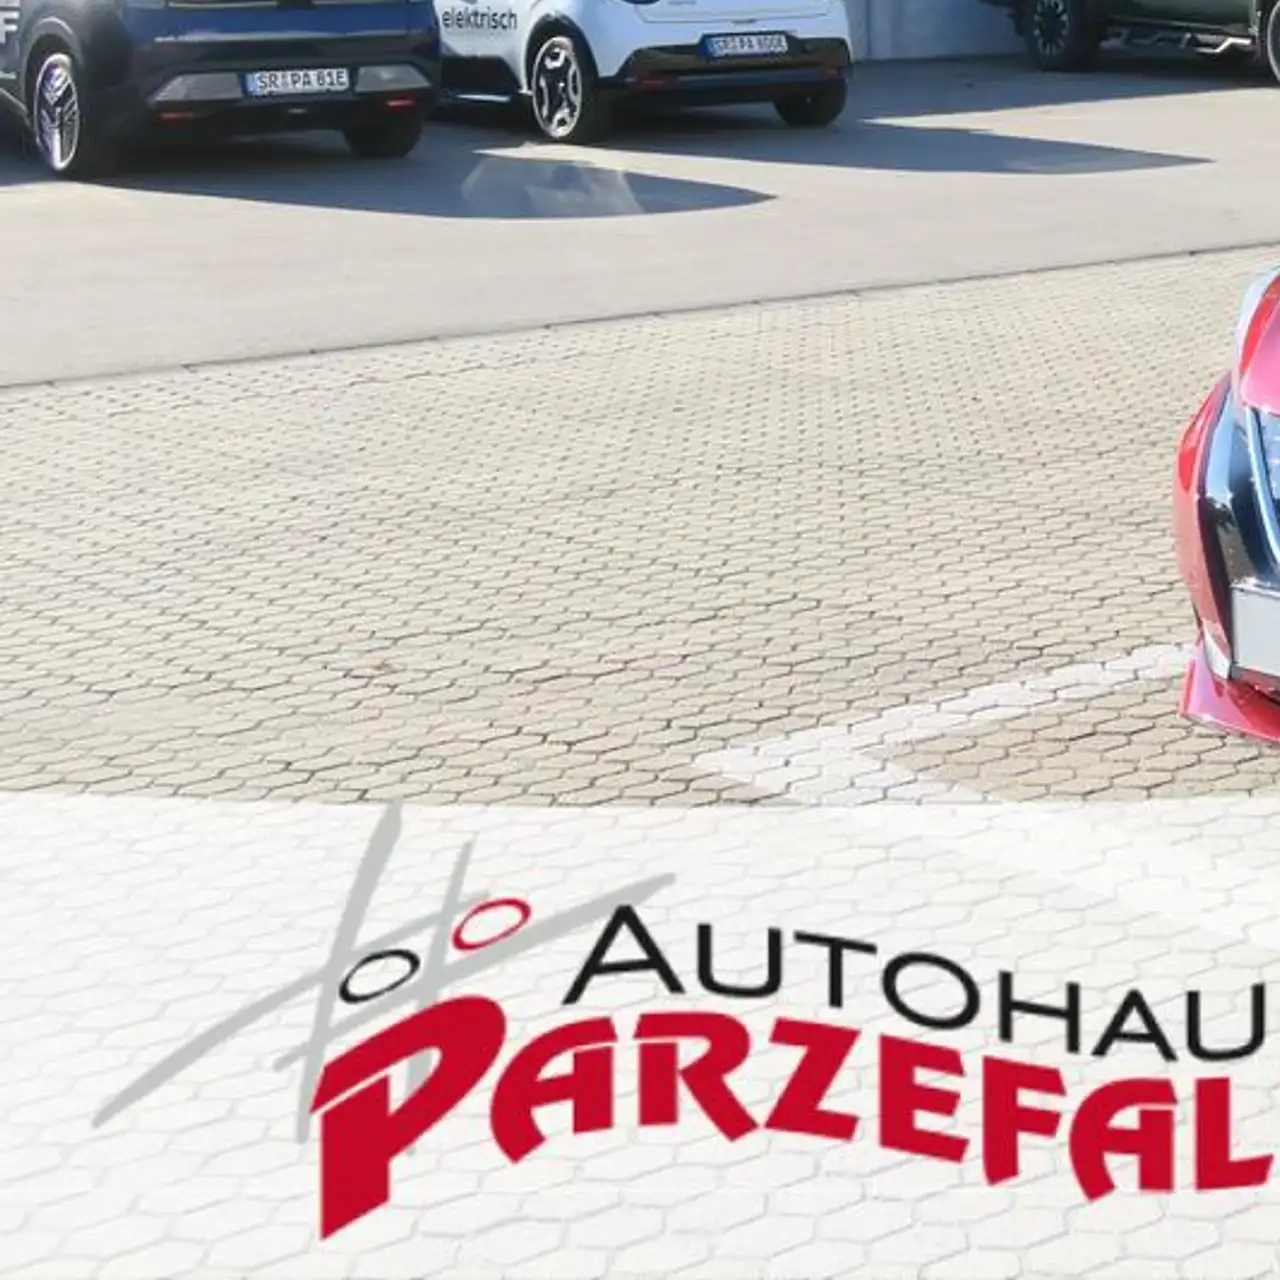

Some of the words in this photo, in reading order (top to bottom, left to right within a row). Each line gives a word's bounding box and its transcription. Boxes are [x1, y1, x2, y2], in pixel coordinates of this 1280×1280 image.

[441, 6, 518, 30] elektrisch
[256, 71, 280, 89] SR
[290, 71, 313, 87] PA
